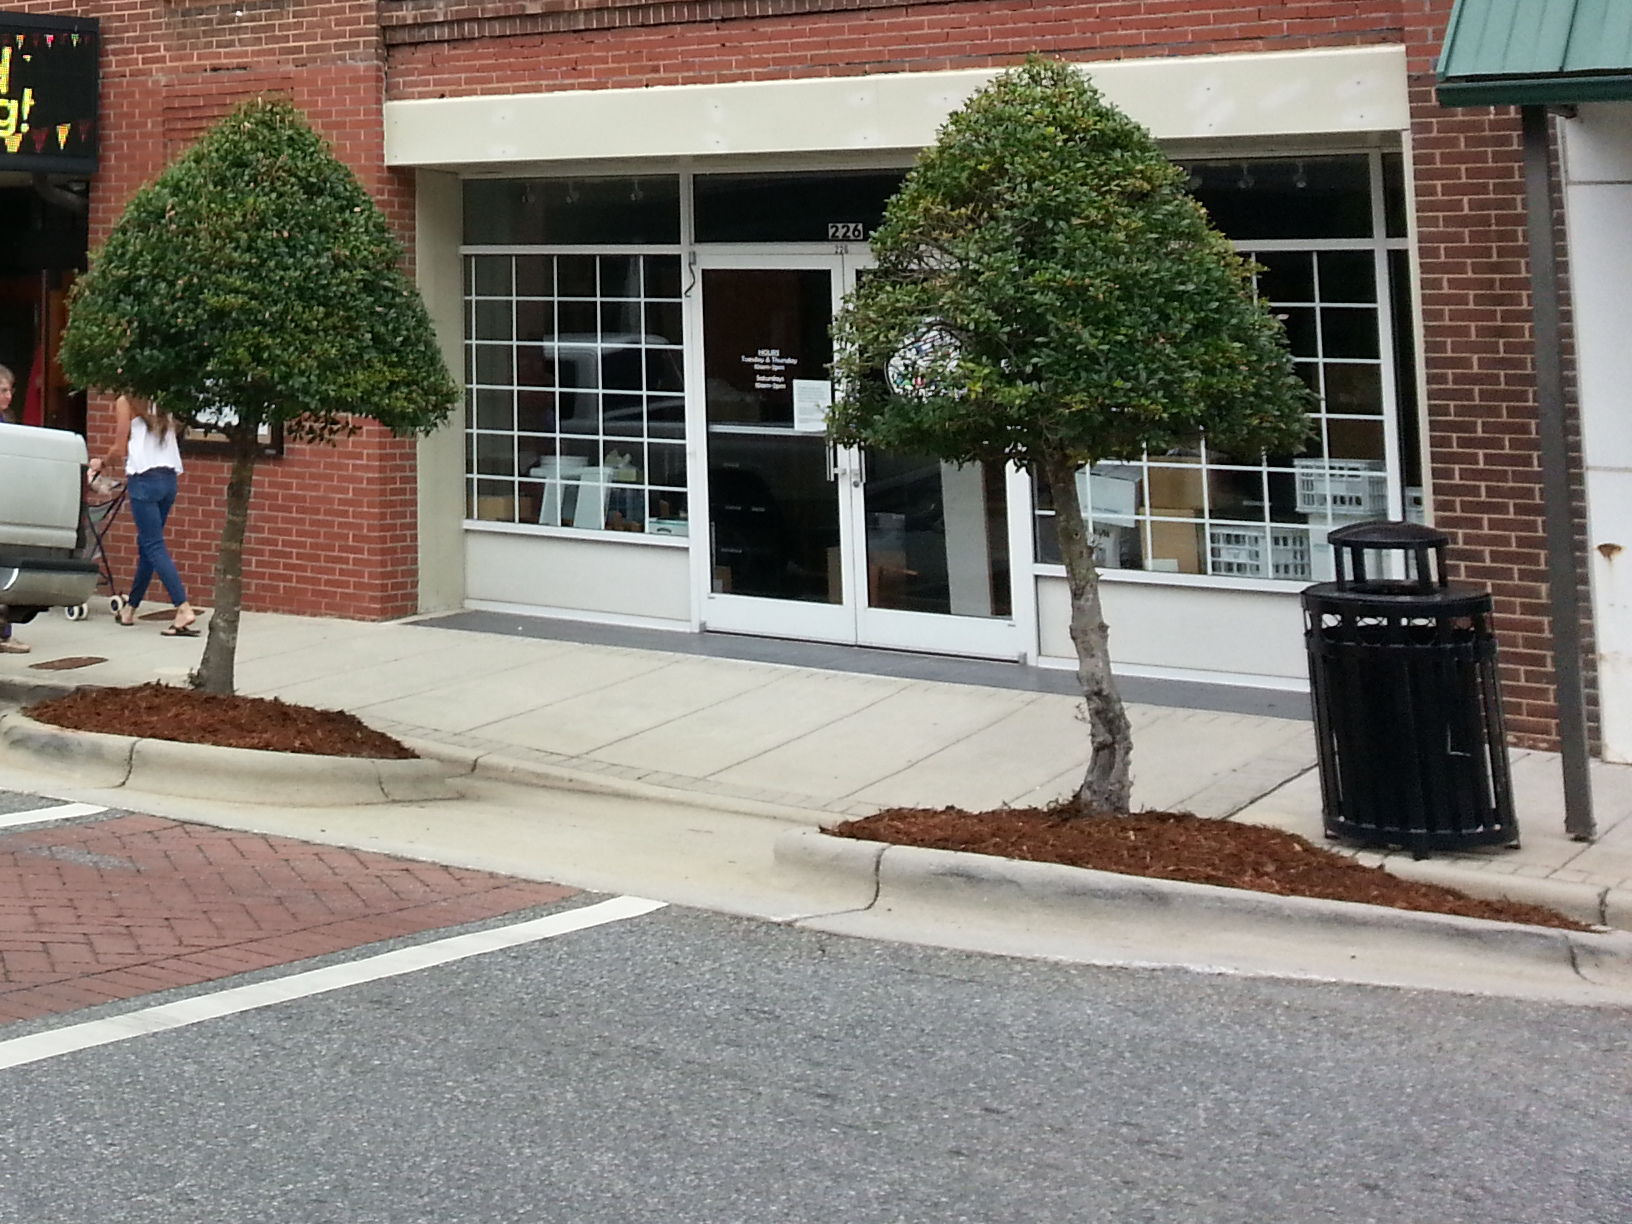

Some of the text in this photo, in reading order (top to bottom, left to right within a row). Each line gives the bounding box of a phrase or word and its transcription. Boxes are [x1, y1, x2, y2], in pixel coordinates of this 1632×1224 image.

[829, 224, 862, 239] 226
[741, 355, 764, 363] Tuesday
[772, 356, 798, 365] Thursday
